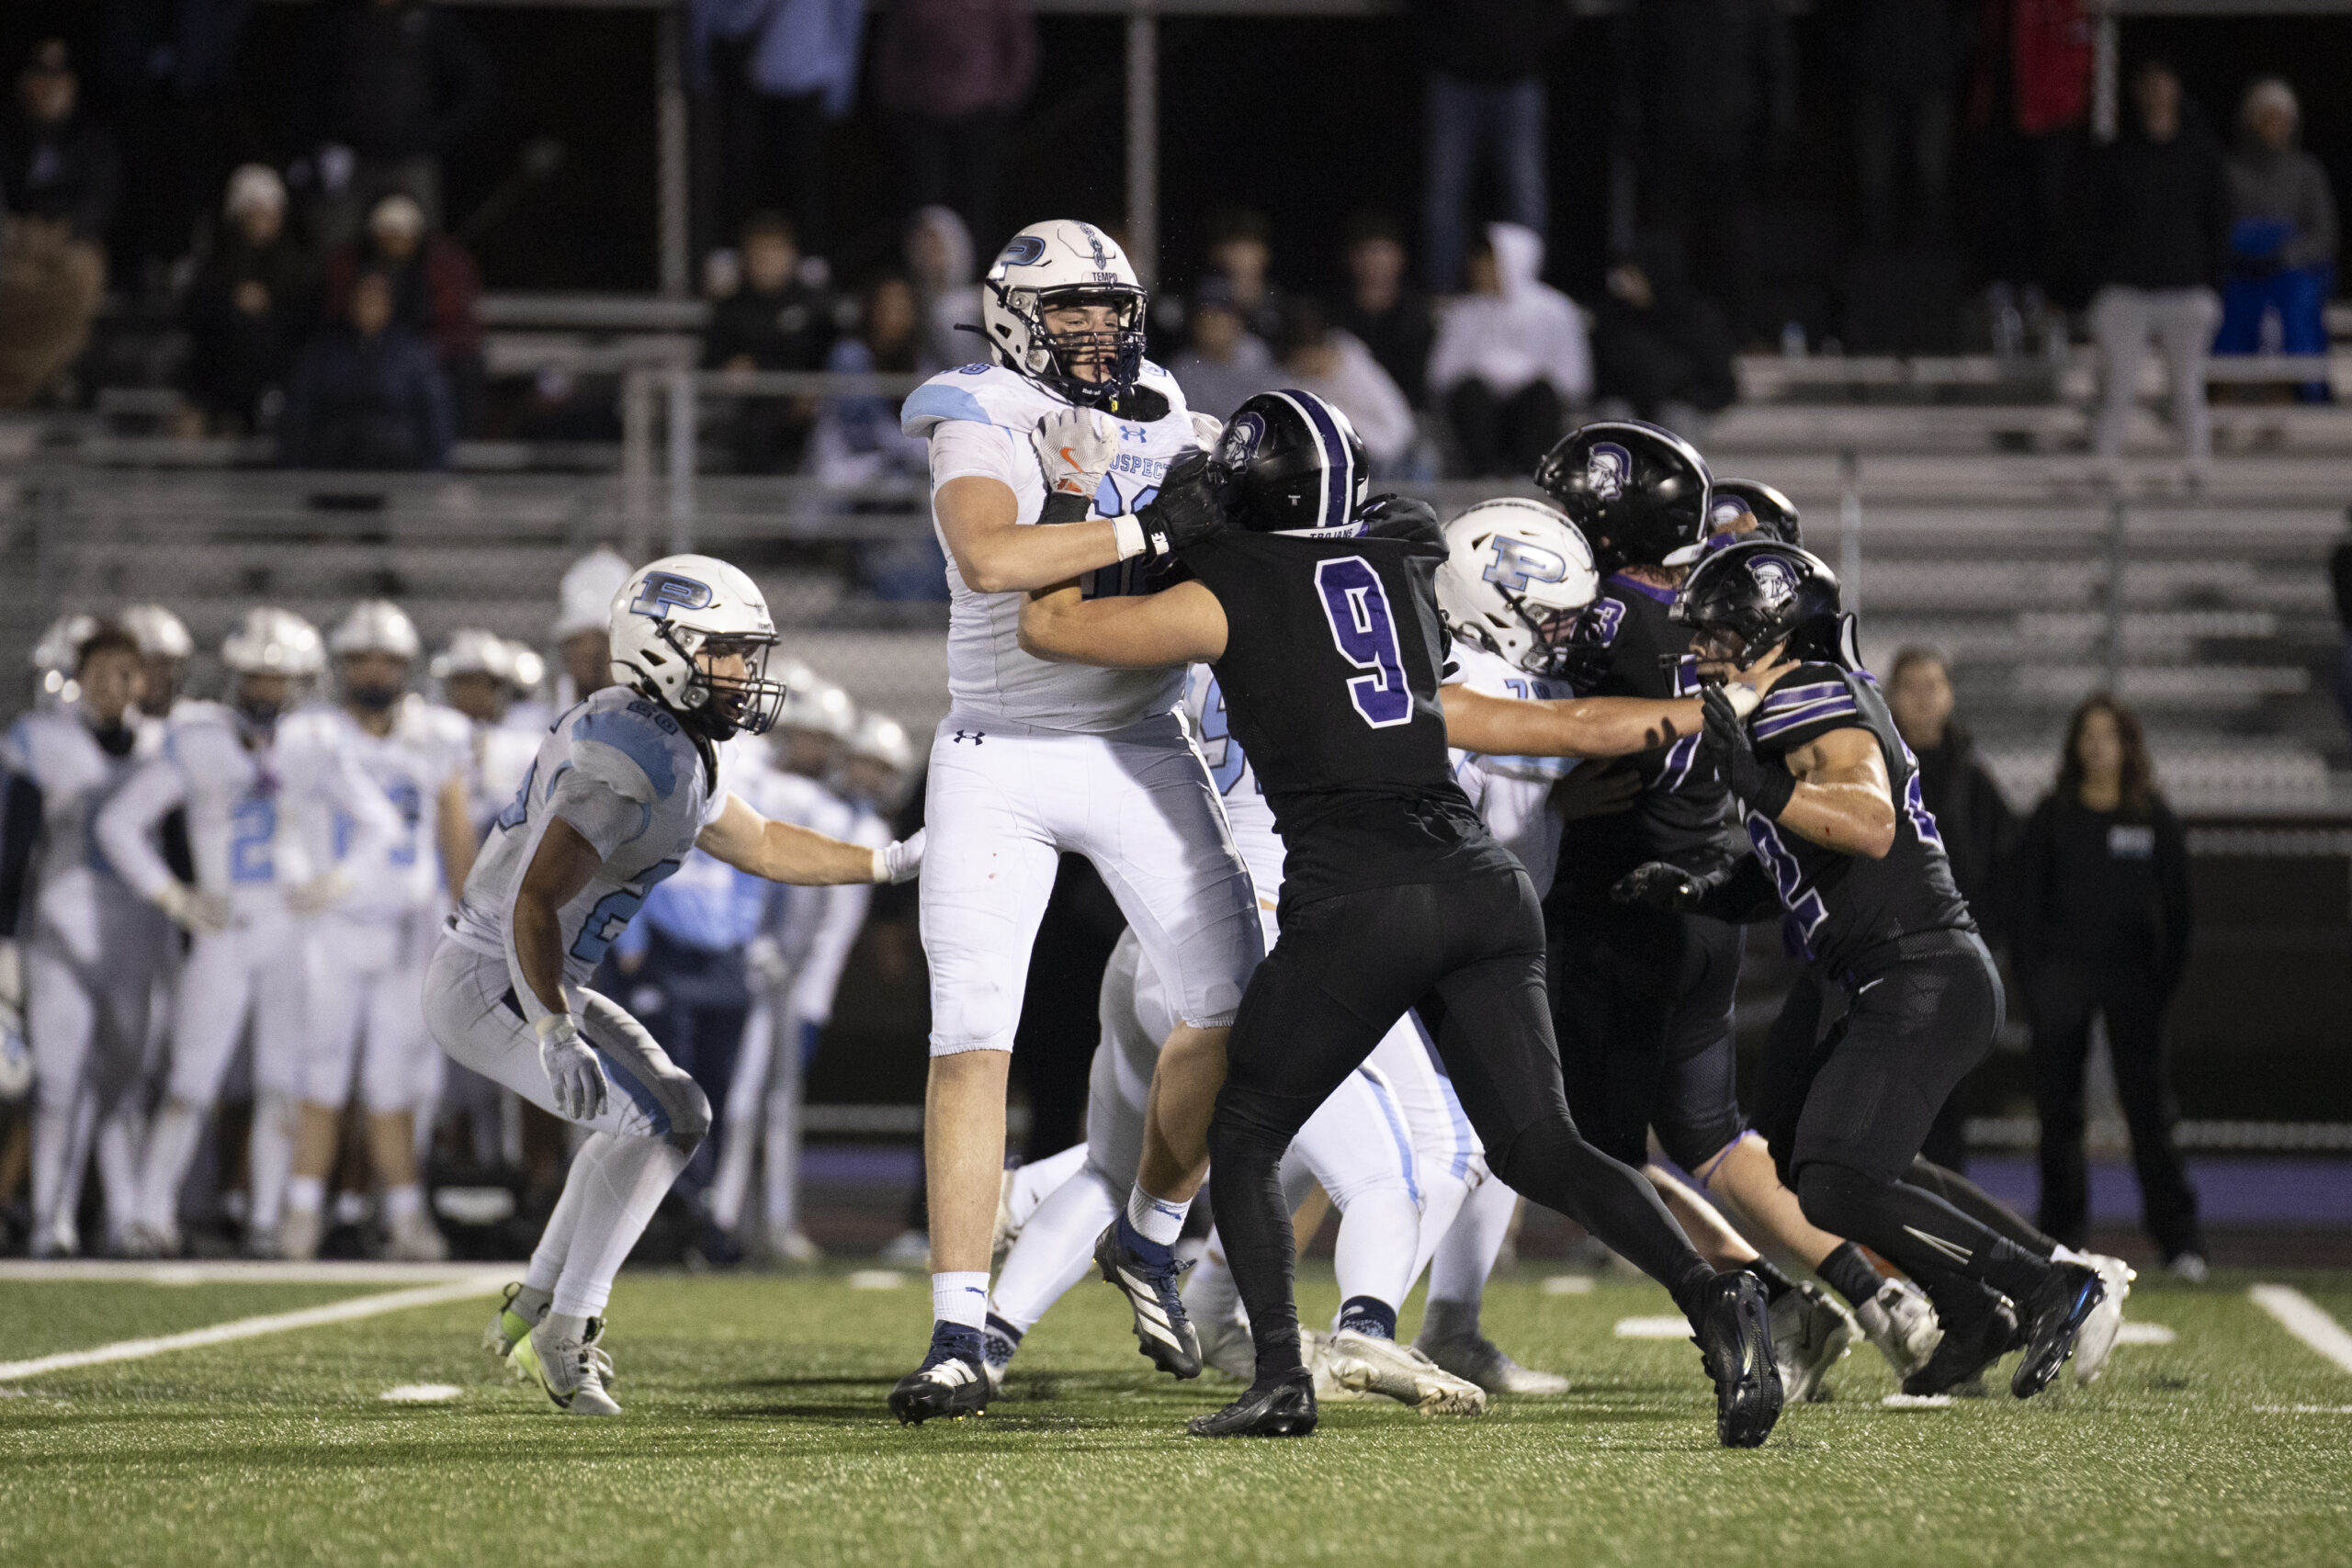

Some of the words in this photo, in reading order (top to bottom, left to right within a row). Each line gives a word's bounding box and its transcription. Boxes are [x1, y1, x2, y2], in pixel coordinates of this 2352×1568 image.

[987, 236, 1046, 281] P
[1091, 271, 1118, 283] TEMPO
[1110, 453, 1172, 479] OSPECT
[1482, 535, 1566, 592] P
[629, 571, 712, 618] P
[1314, 555, 1414, 729] 9
